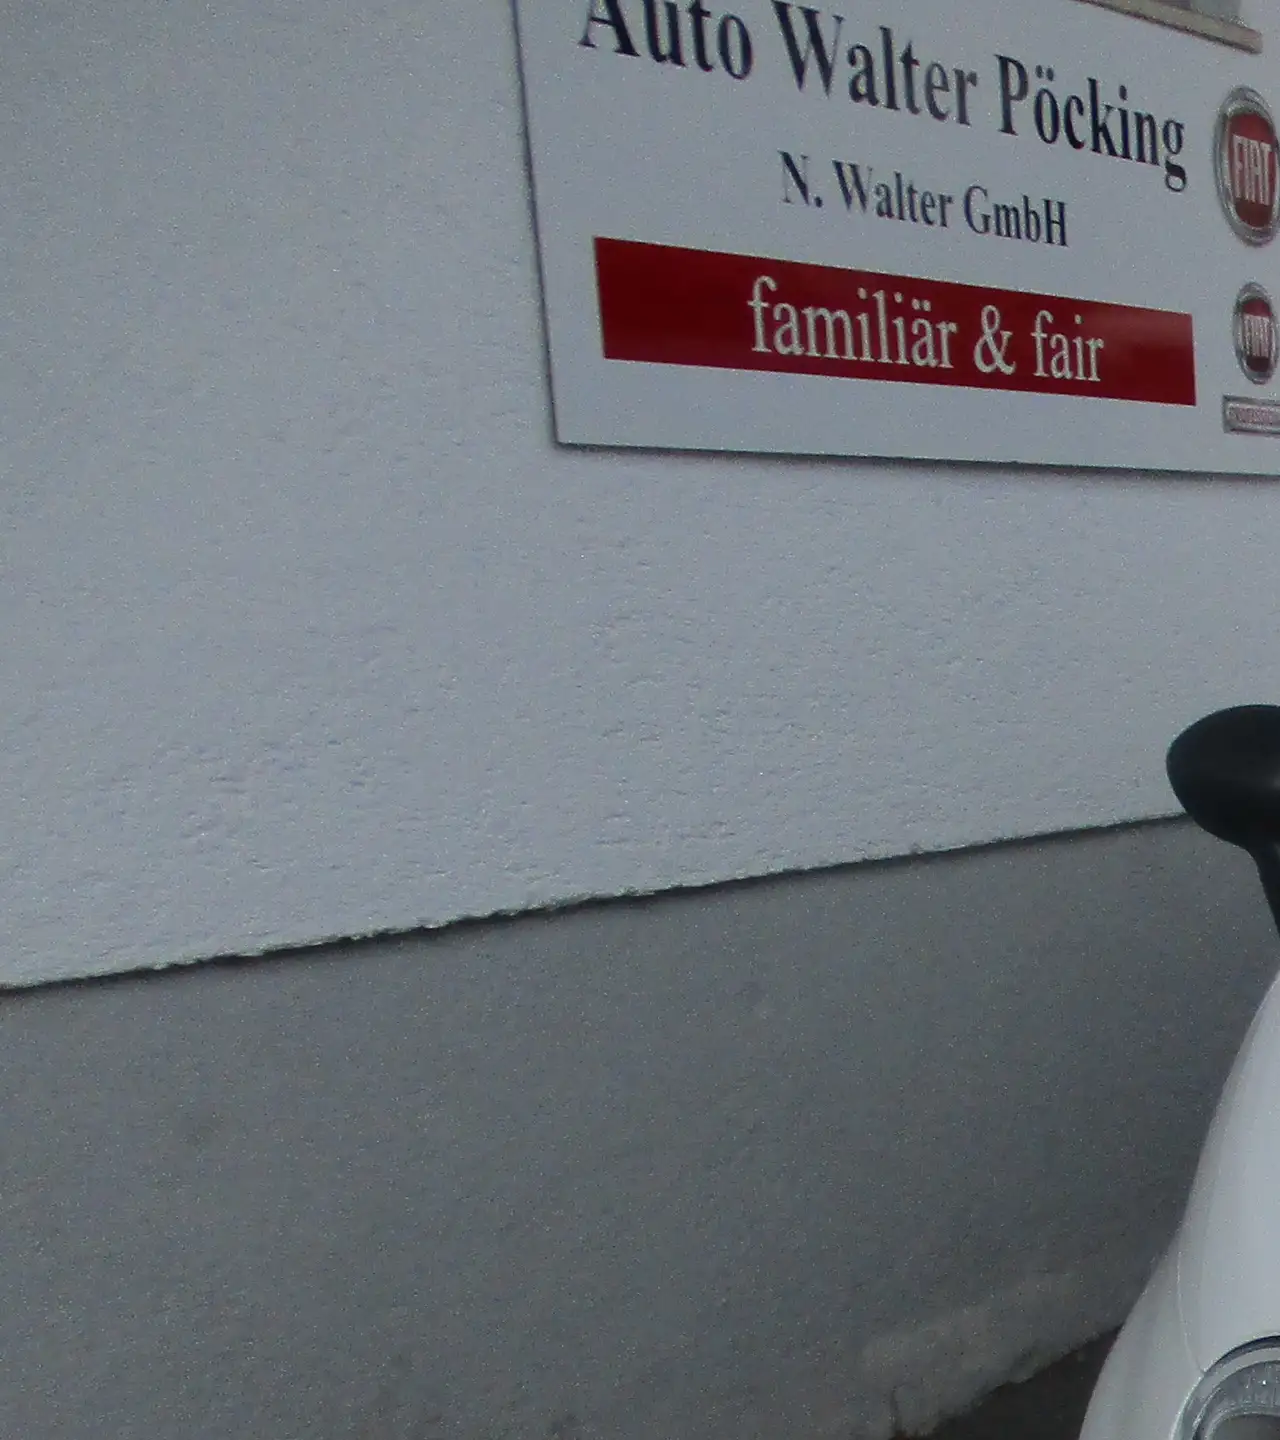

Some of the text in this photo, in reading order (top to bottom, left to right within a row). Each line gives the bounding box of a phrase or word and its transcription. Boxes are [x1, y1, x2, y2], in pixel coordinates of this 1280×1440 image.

[578, 0, 752, 80] Auto
[770, 0, 978, 126] Walter
[995, 54, 1187, 192] Pöcking
[777, 150, 1068, 247] N. Walter GmbH
[1231, 133, 1273, 206] FIAT
[747, 275, 1104, 382] familiär & fair
